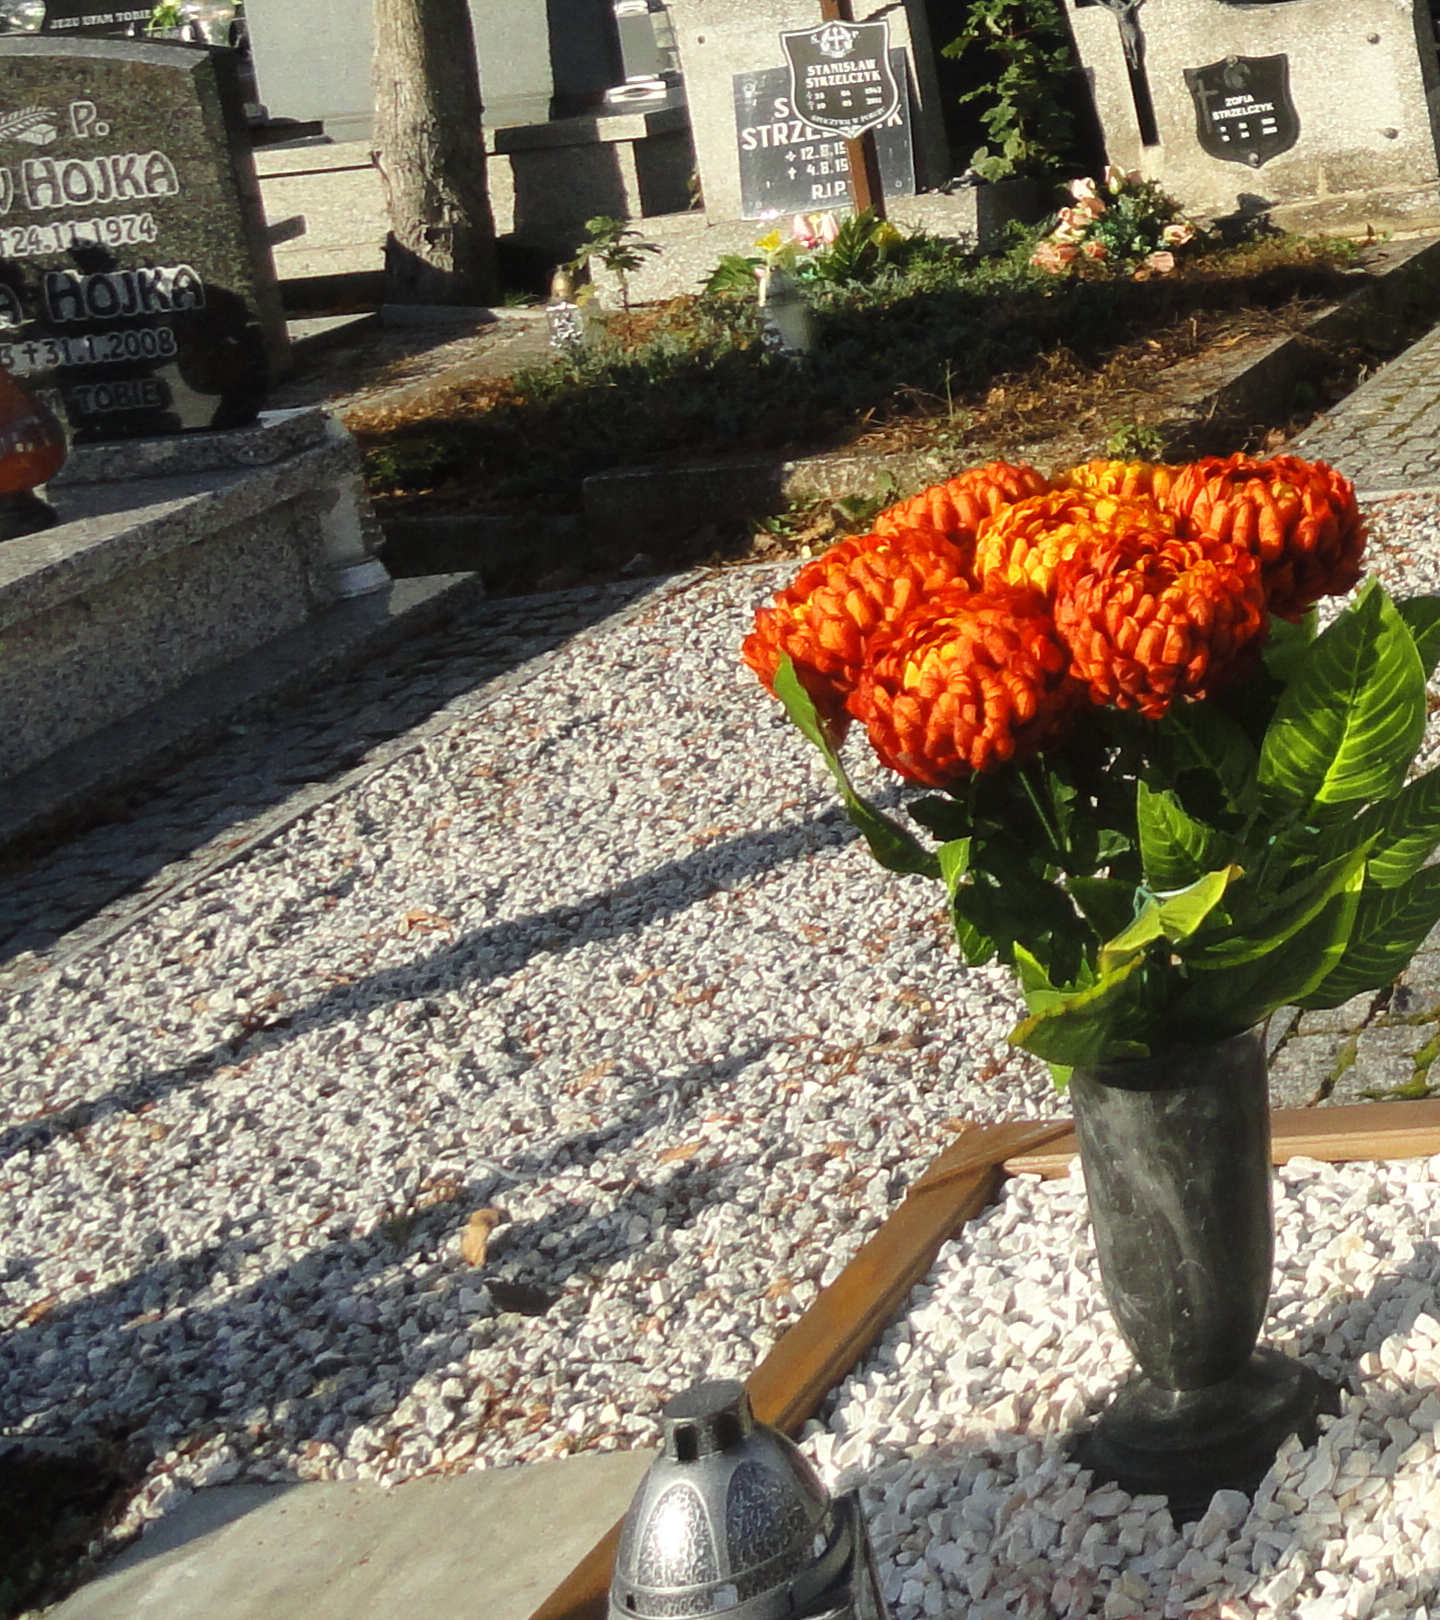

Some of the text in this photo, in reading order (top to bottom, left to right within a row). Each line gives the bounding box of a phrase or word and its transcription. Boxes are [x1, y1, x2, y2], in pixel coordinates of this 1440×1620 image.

[805, 70, 882, 90] STRZELCZYK
[69, 91, 110, 138] P.
[1211, 101, 1275, 121] STRZELCZYK
[1224, 93, 1254, 108] ZOFIA
[22, 150, 180, 211] HOJKA
[45, 264, 206, 323] HOJKA
